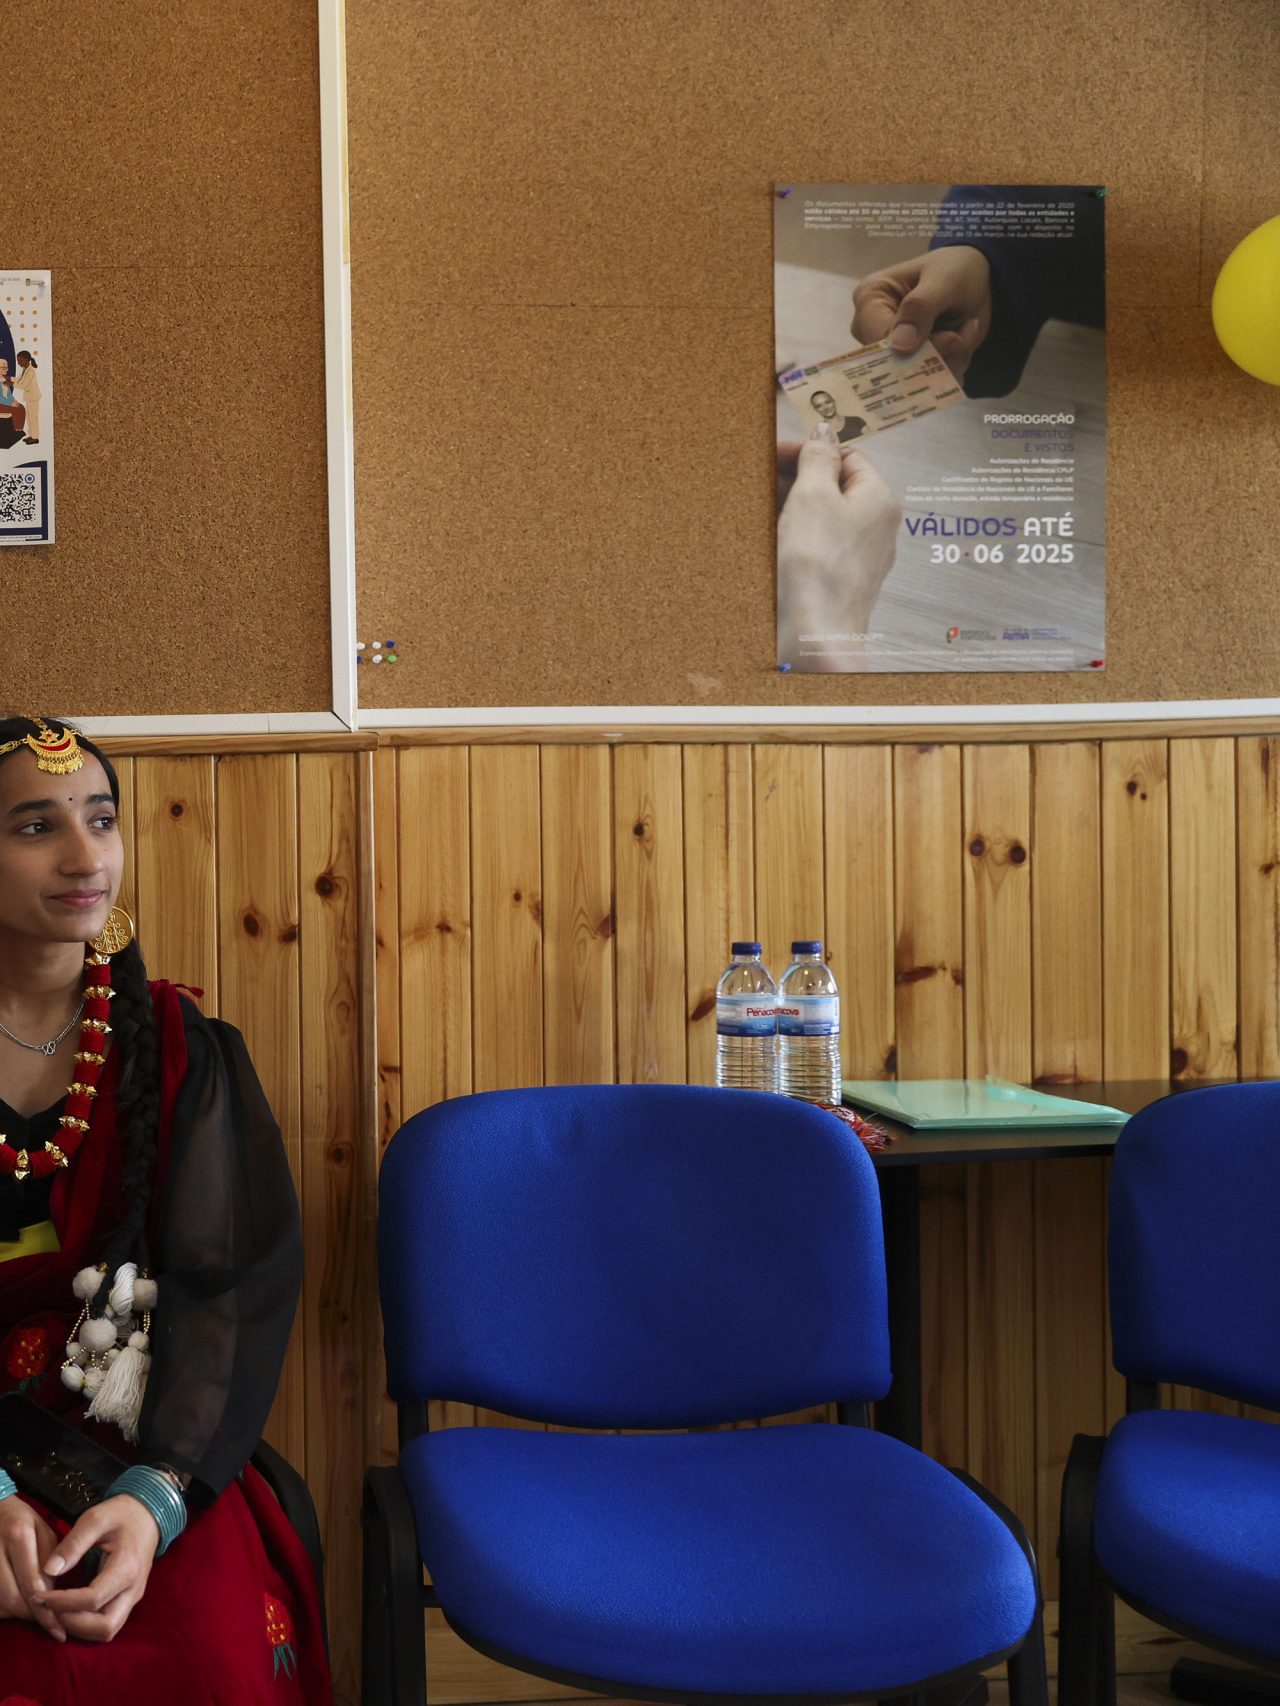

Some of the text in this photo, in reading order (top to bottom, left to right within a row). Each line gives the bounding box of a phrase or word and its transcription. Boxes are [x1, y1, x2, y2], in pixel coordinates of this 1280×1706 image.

[984, 413, 1075, 426] PRORROGAÇÃO
[992, 429, 1075, 439] DOCUMENTOS
[1024, 443, 1074, 452] E VISTOS
[905, 512, 1074, 537] VÁLIDOS ATÉ
[930, 543, 1074, 564] 30 06 2025
